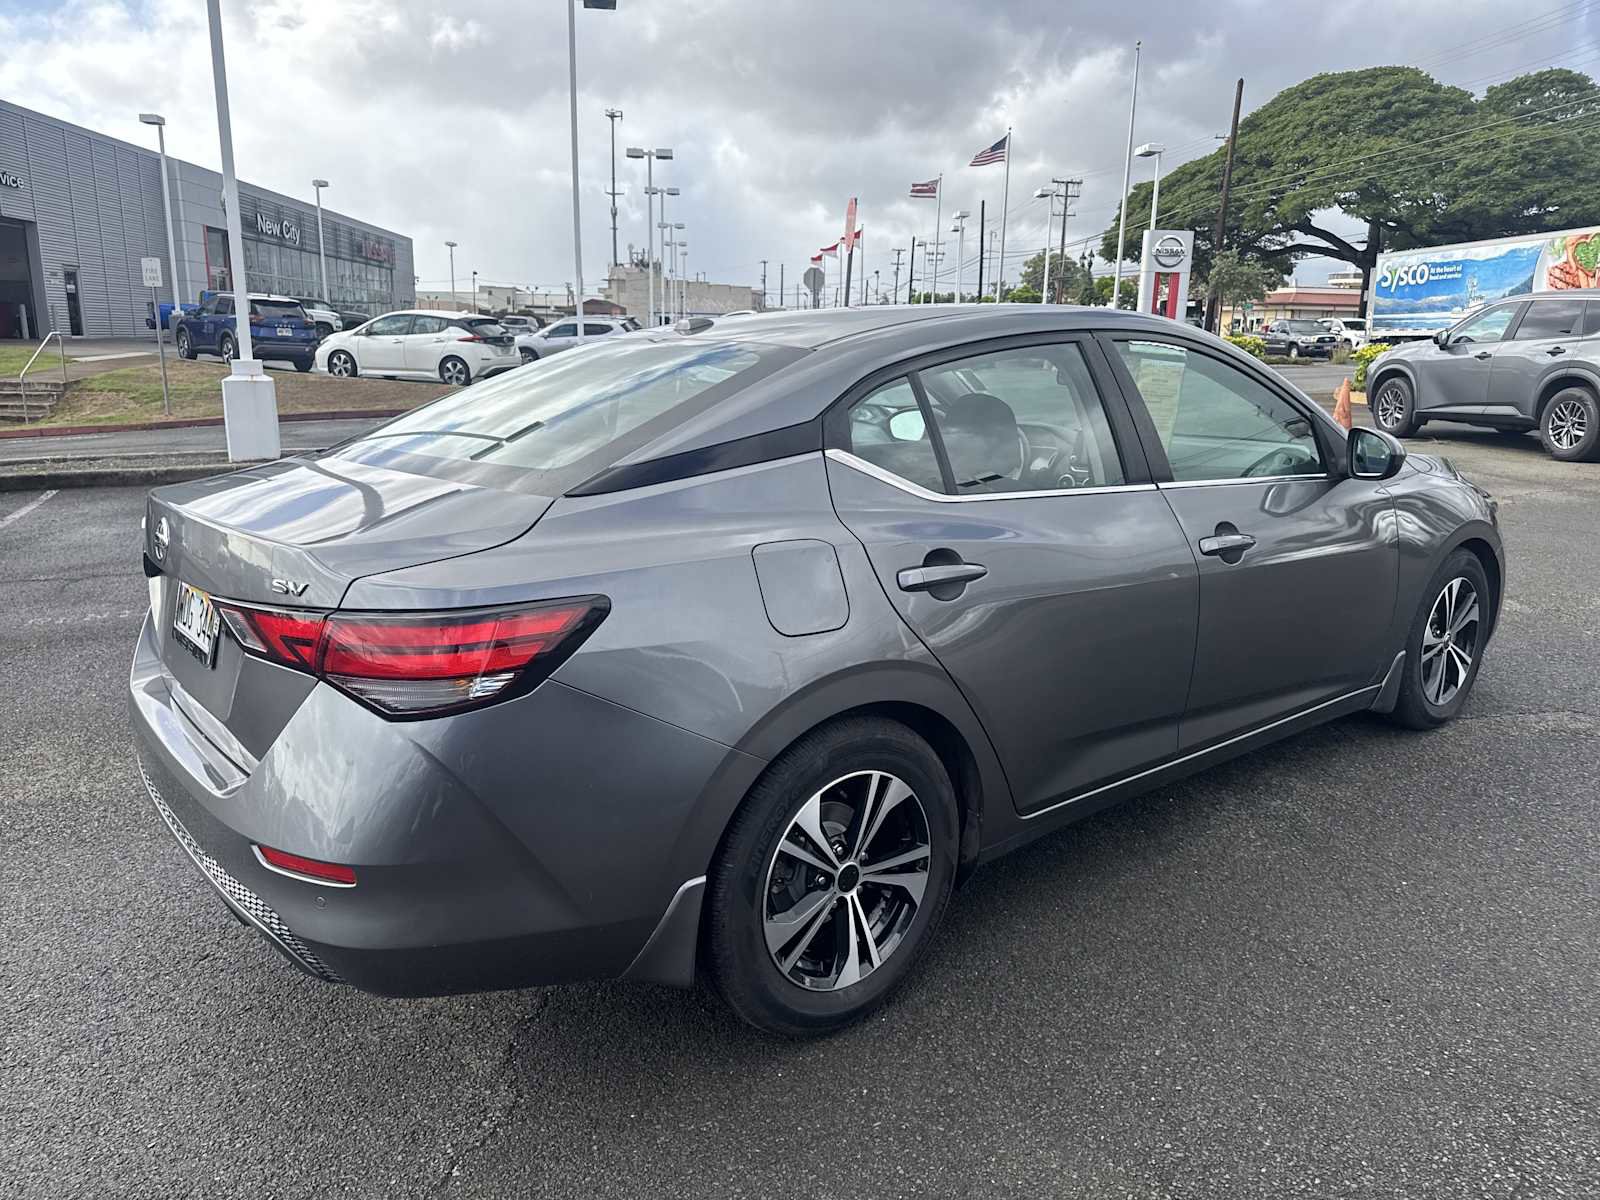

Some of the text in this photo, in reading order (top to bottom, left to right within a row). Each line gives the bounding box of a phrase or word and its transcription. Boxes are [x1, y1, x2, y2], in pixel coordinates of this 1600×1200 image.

[256, 213, 300, 245] New City
[1152, 247, 1188, 256] NISSAN
[271, 579, 309, 597] SV
